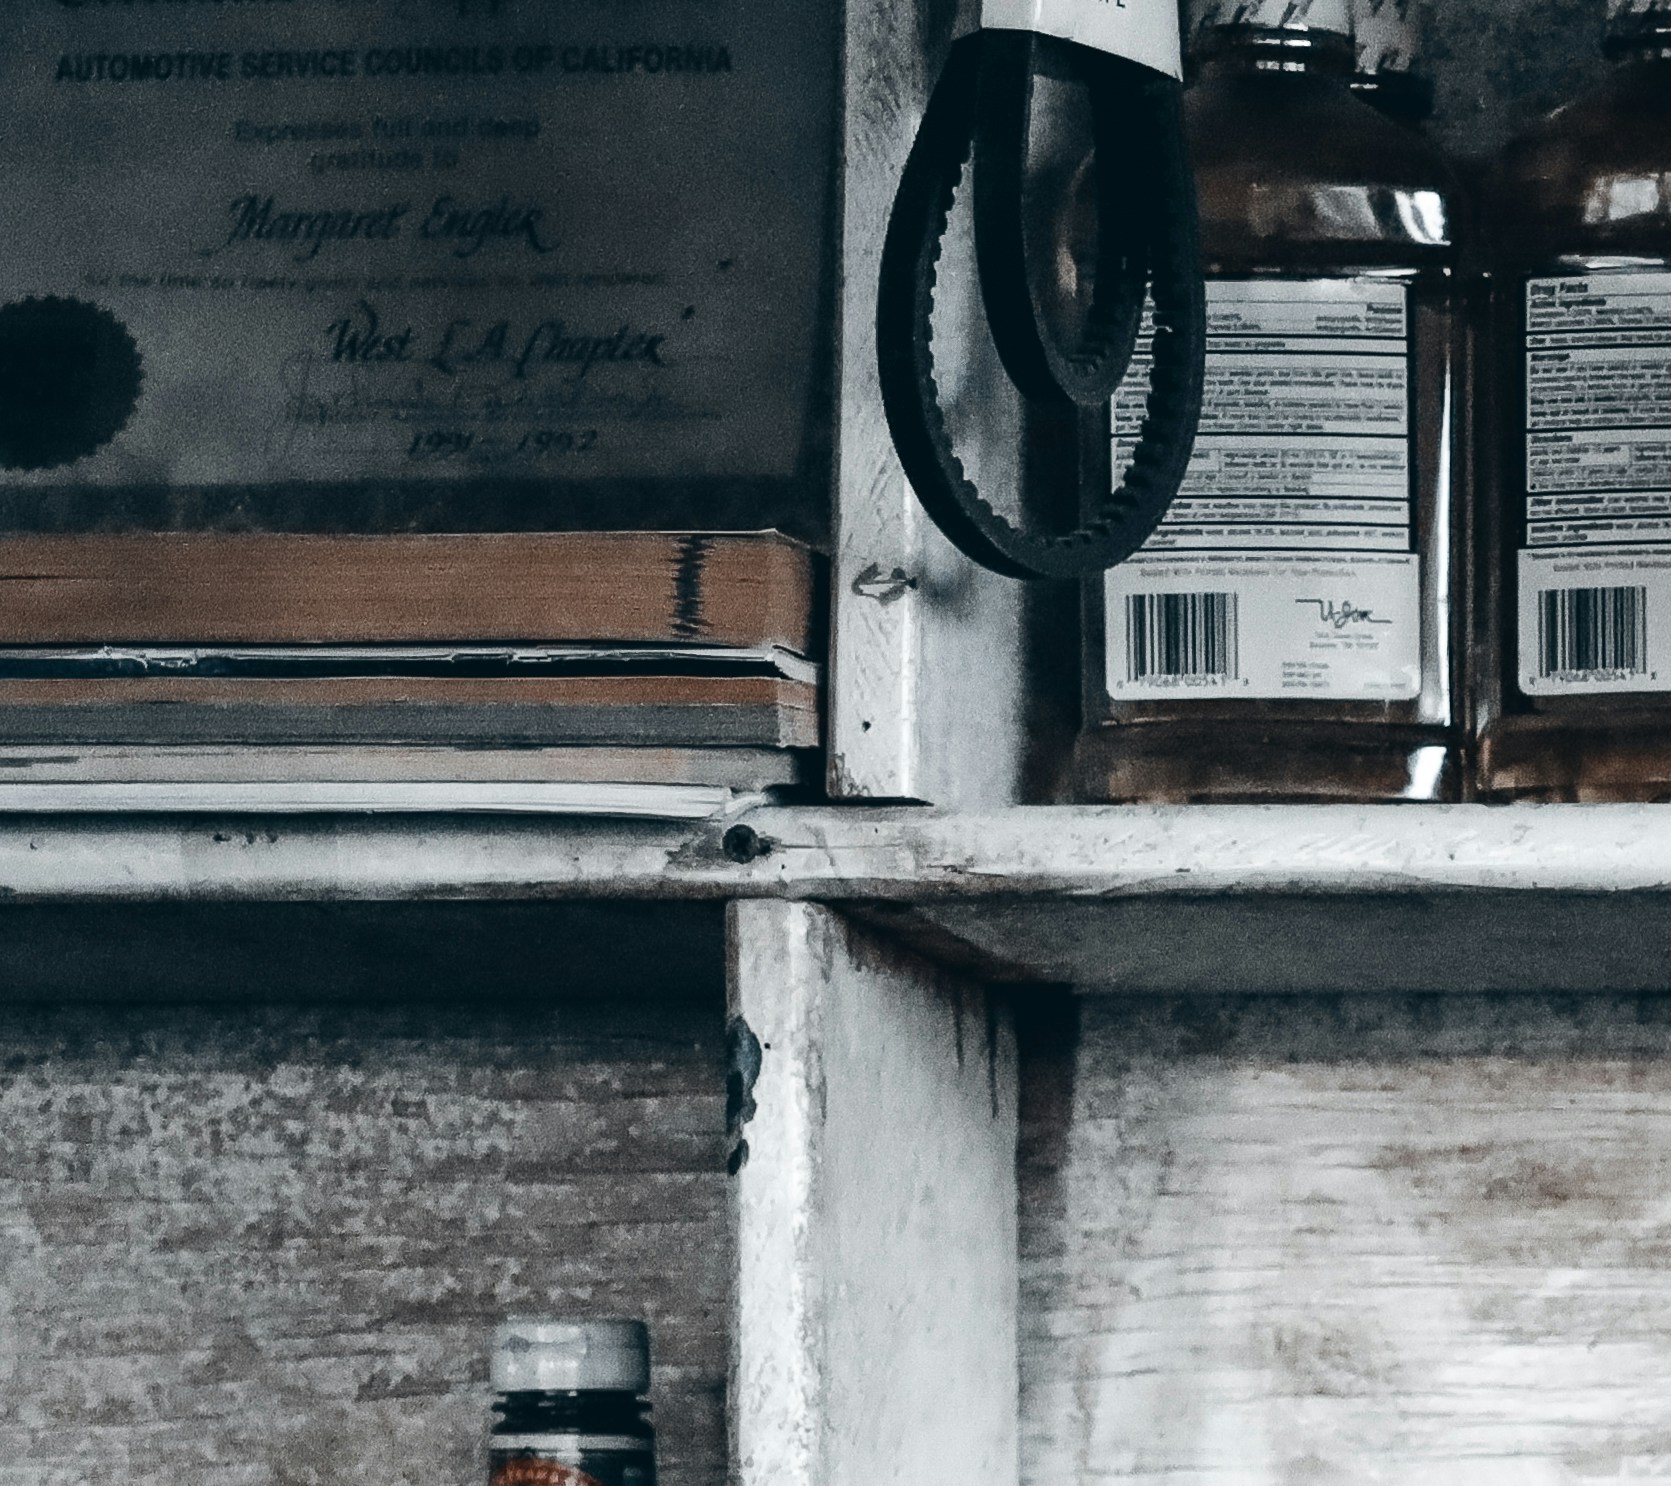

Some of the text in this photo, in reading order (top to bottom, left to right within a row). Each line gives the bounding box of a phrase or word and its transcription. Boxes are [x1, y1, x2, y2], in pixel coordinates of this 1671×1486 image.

[56, 45, 733, 82] AUTOMOTIVE SERVICE COUNCILS OF CALIFORNIA
